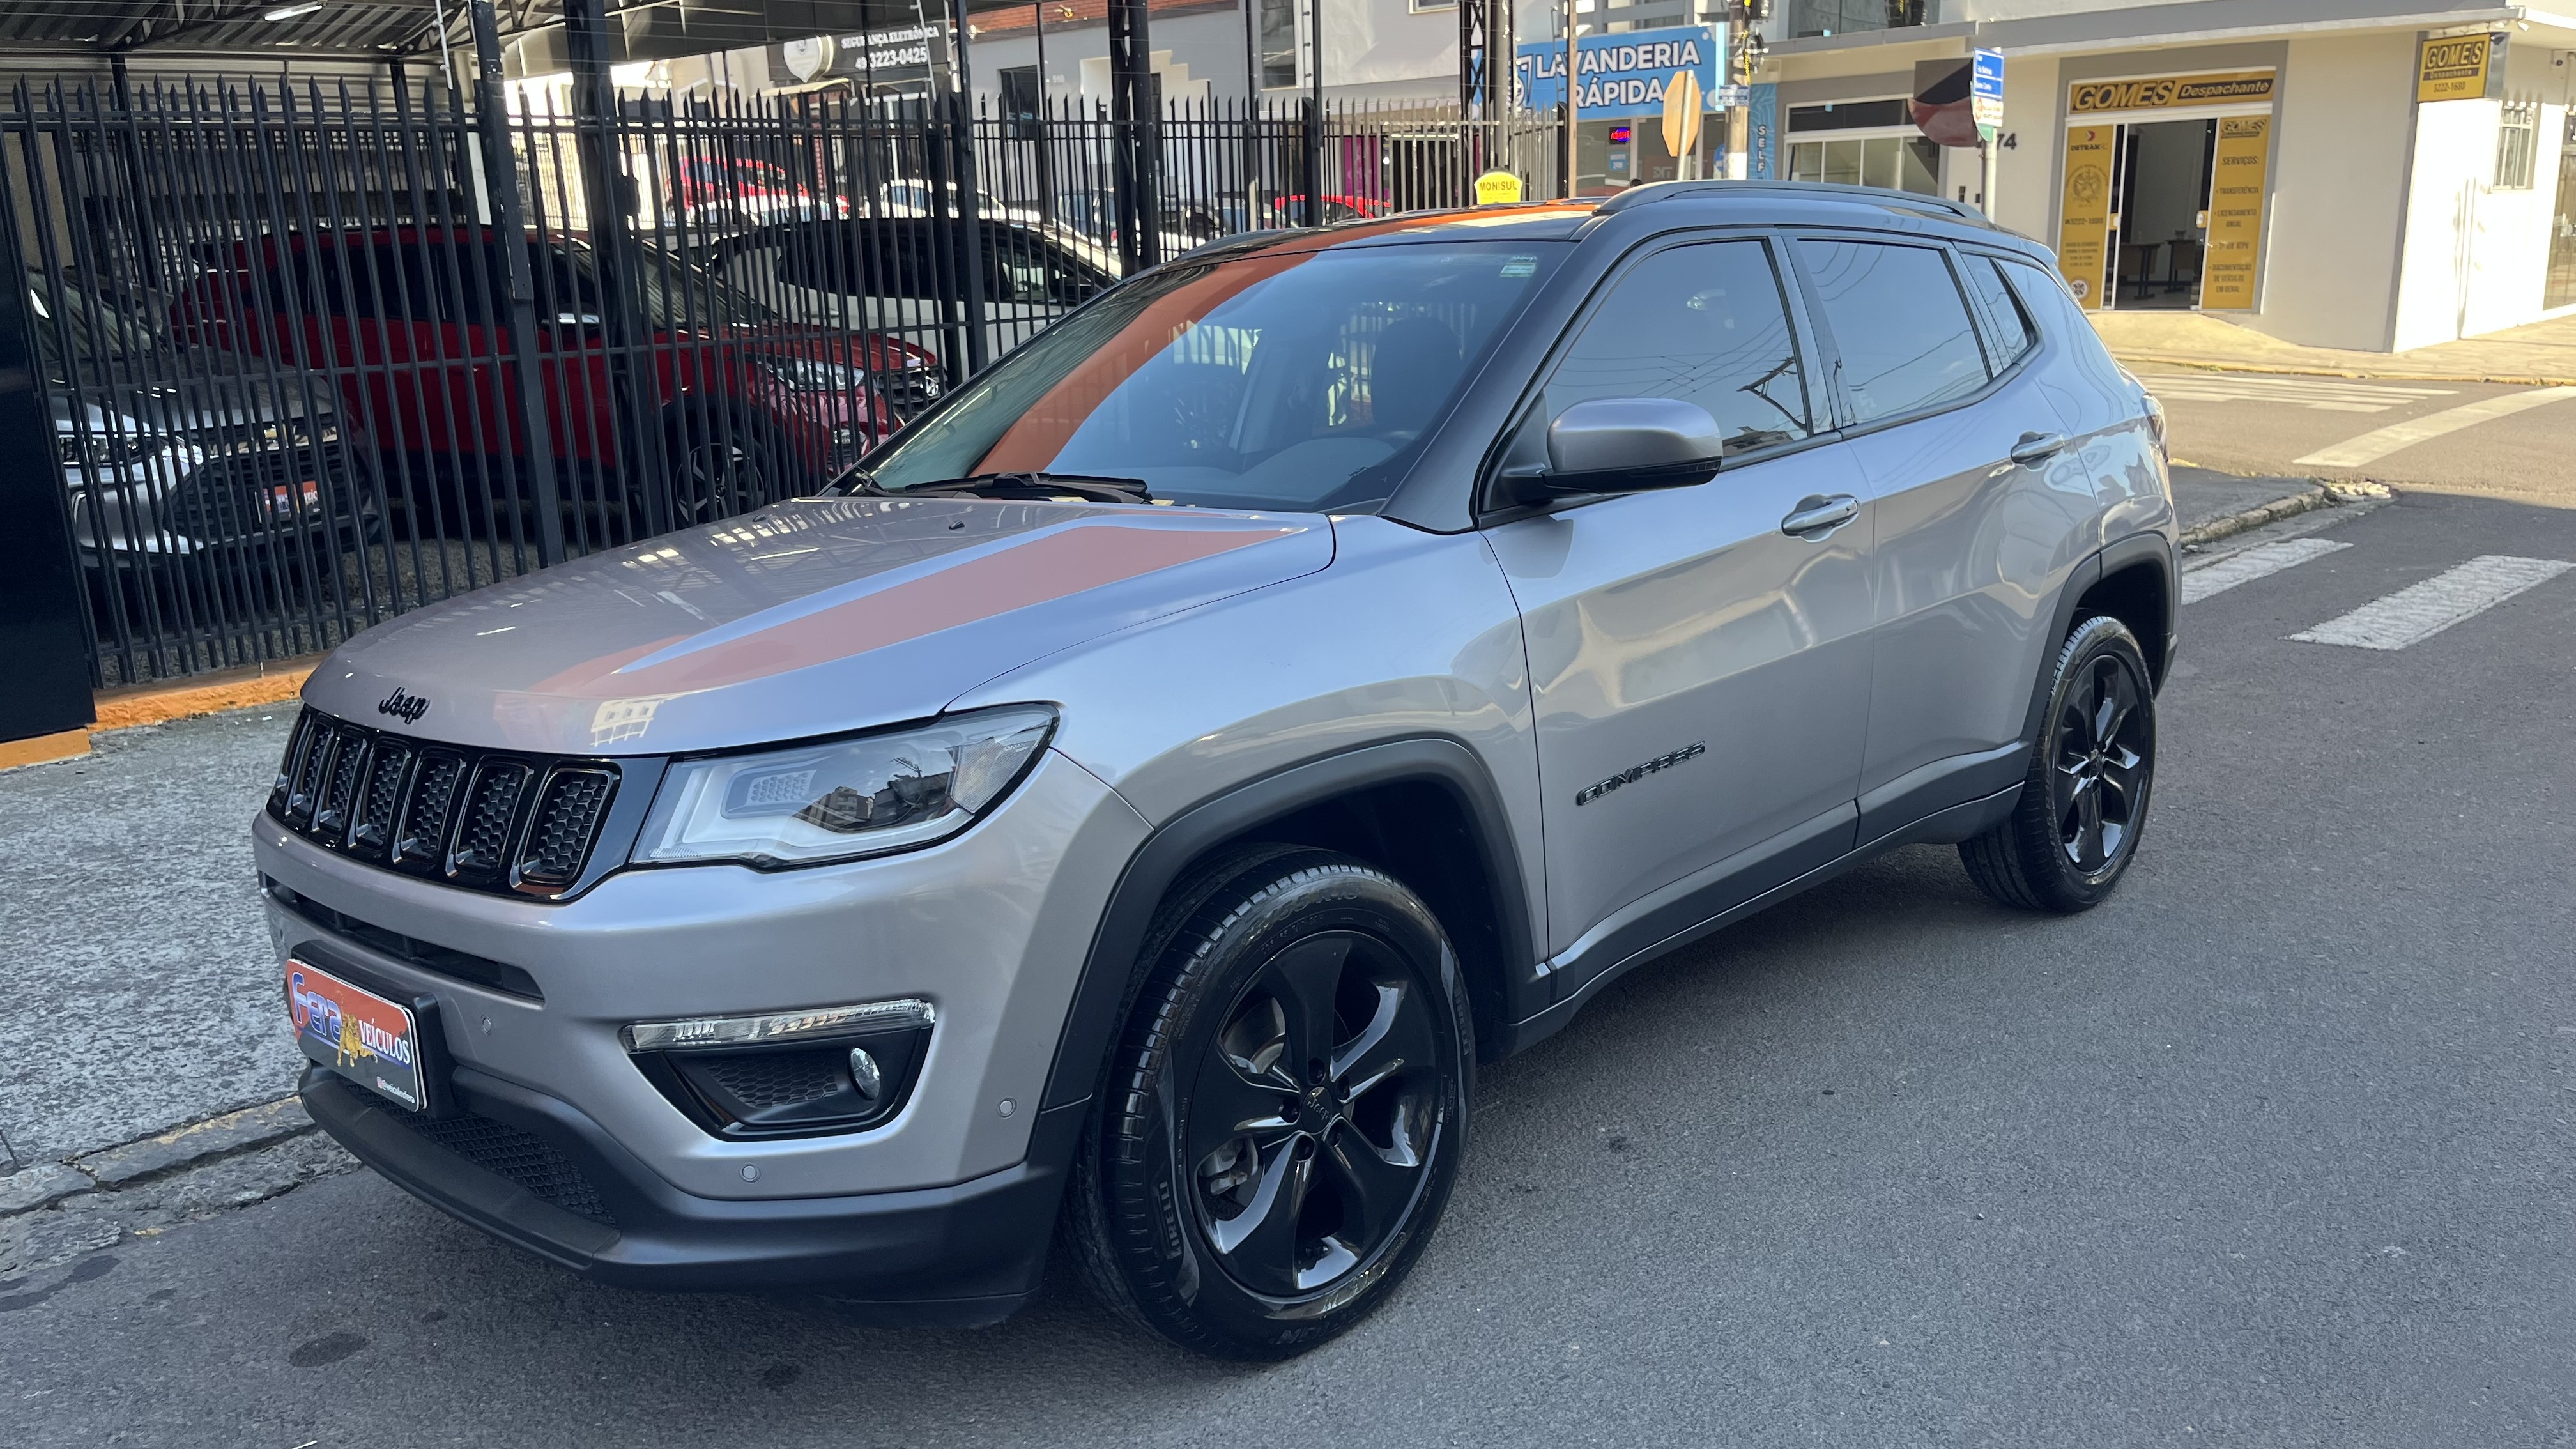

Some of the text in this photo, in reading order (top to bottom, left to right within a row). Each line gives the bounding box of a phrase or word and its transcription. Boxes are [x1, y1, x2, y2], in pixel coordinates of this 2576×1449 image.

[870, 46, 928, 68] 3223-0425
[1535, 40, 1701, 79] LAVANDERIA
[2427, 42, 2483, 68] GOMES
[1576, 76, 1664, 108] RÁPIDA
[2074, 80, 2270, 110] GOMES Despachante
[1758, 125, 1767, 173] SELF
[1479, 181, 1517, 191] MONISUL
[378, 686, 430, 724] Jeep
[1576, 740, 1705, 806] COMPASS
[292, 972, 410, 1064] Fera VEÍCULOS
[1307, 1098, 1329, 1120] Jeep
